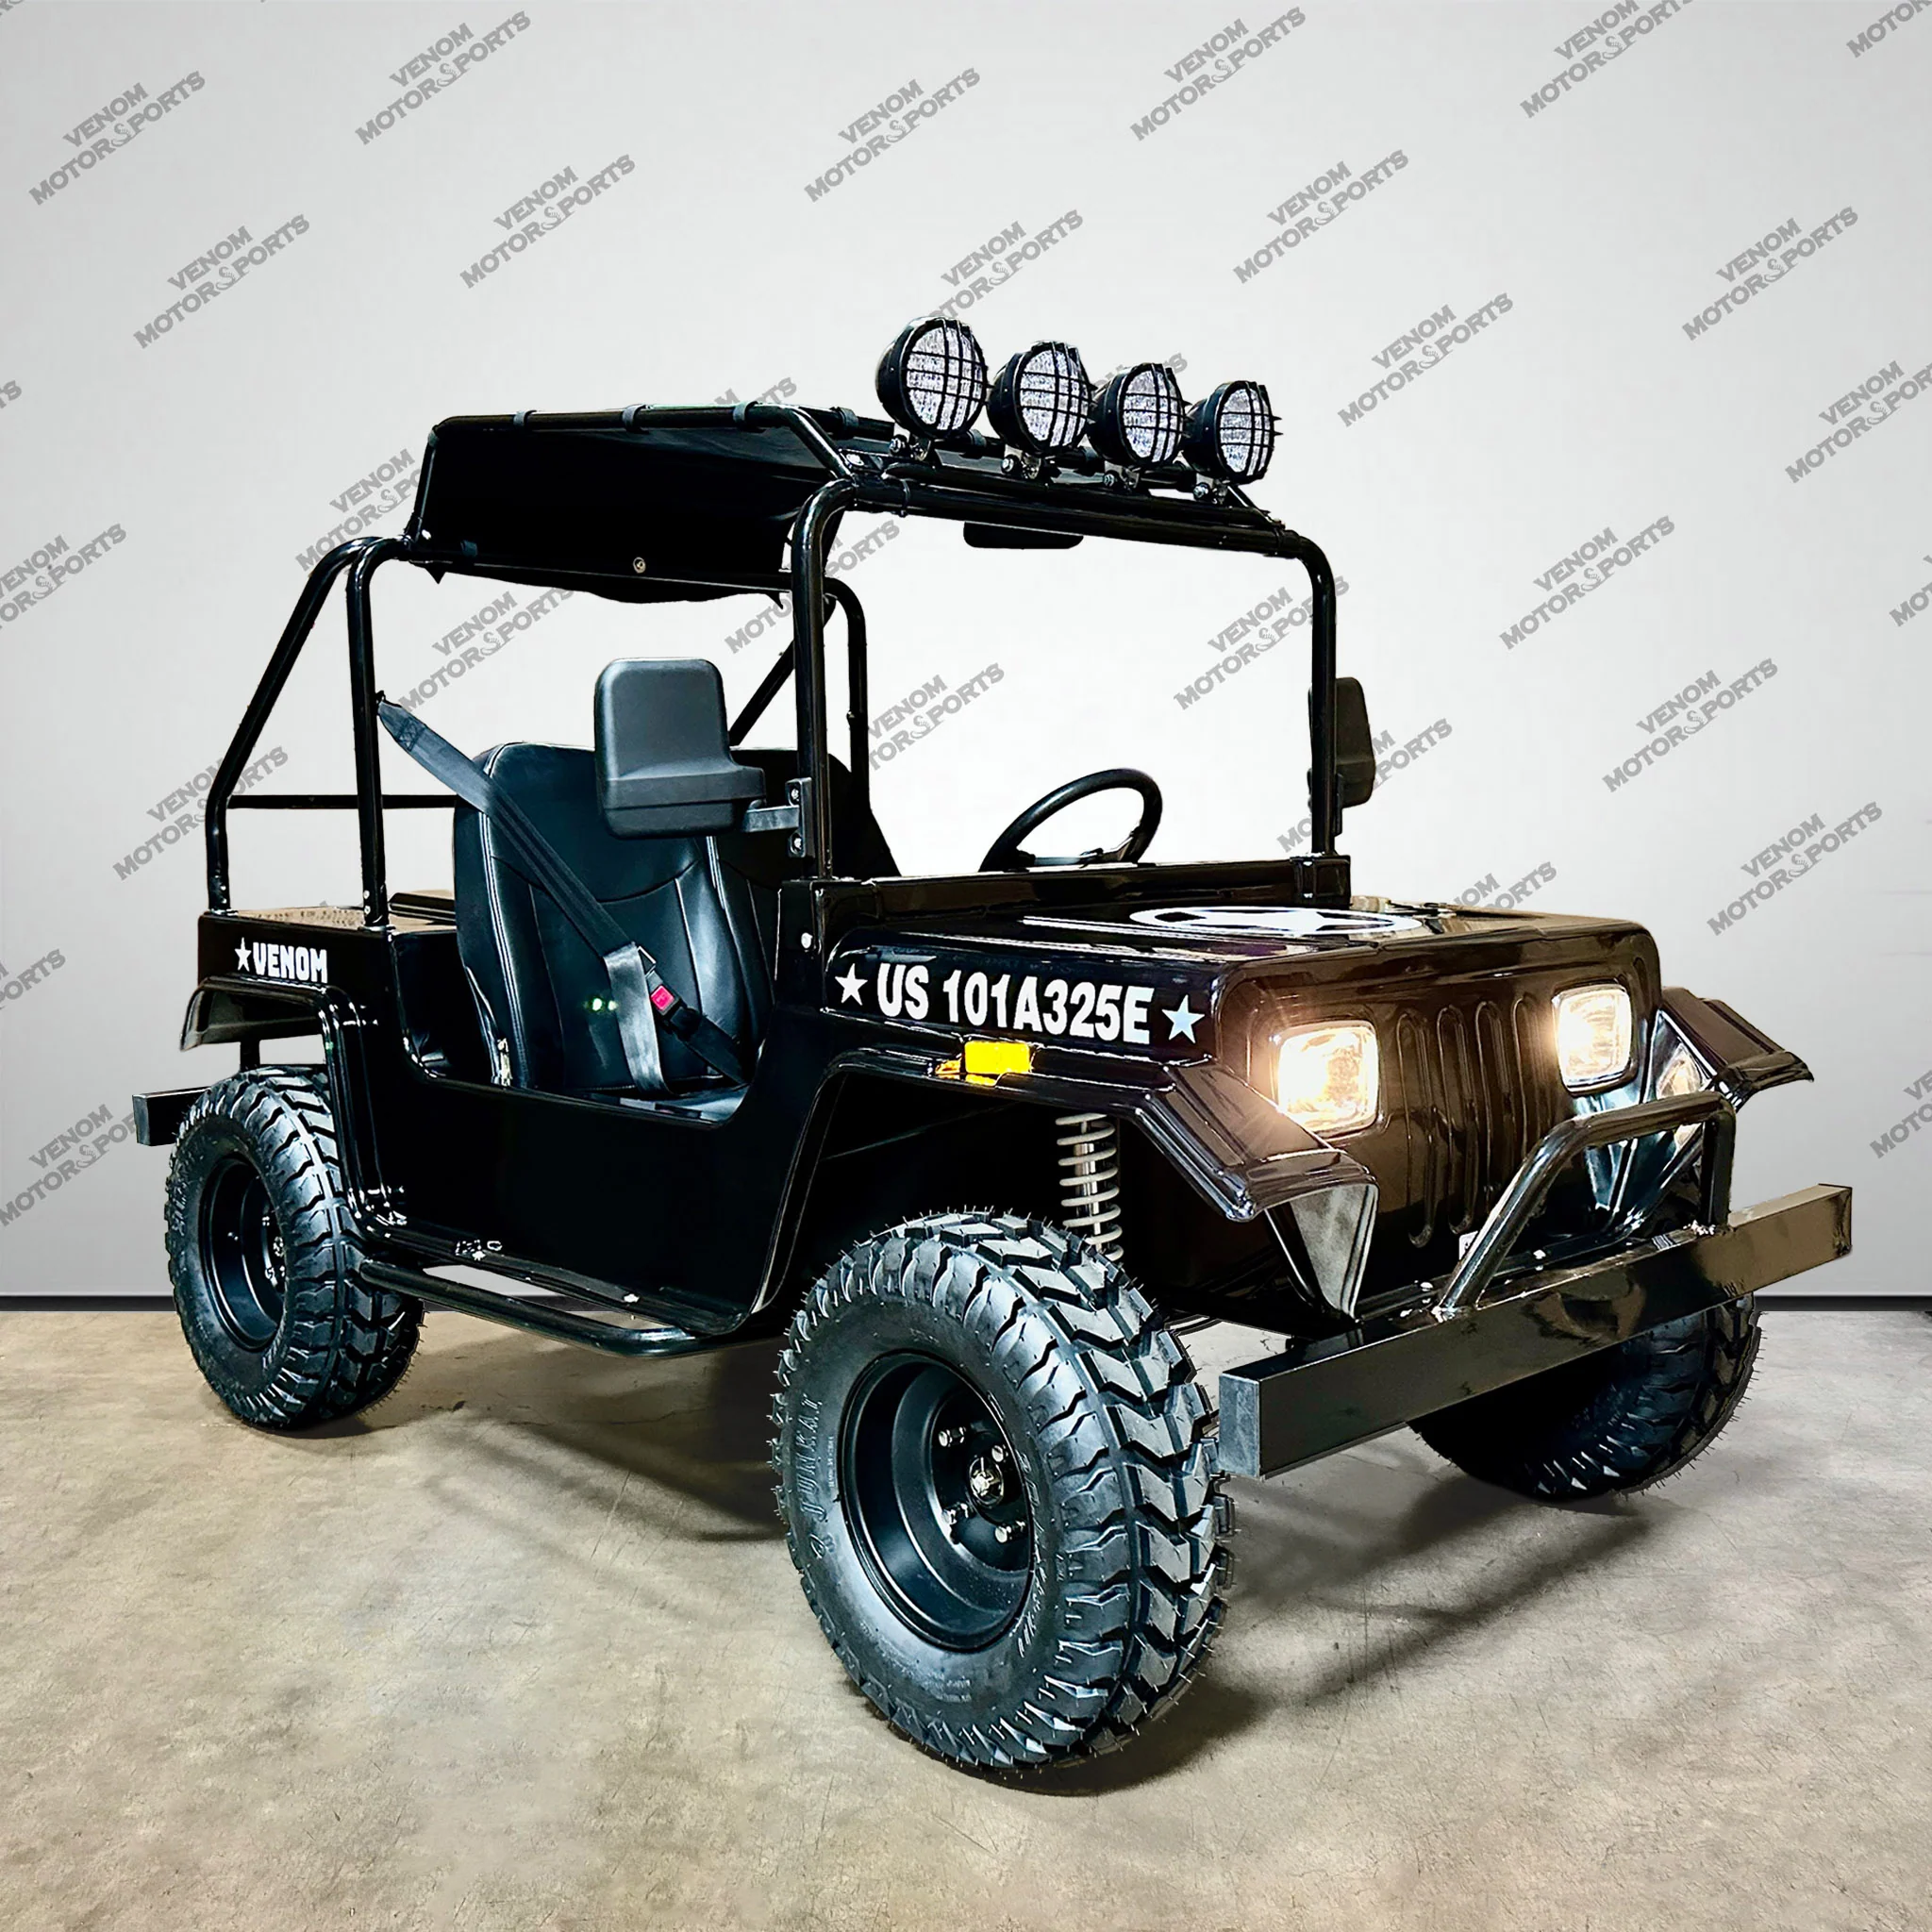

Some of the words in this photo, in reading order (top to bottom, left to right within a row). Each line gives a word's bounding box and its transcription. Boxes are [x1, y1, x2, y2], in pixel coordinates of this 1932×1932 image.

[253, 942, 328, 983] VENOM
[877, 962, 929, 1020] US
[943, 969, 1155, 1044] 101A325E
